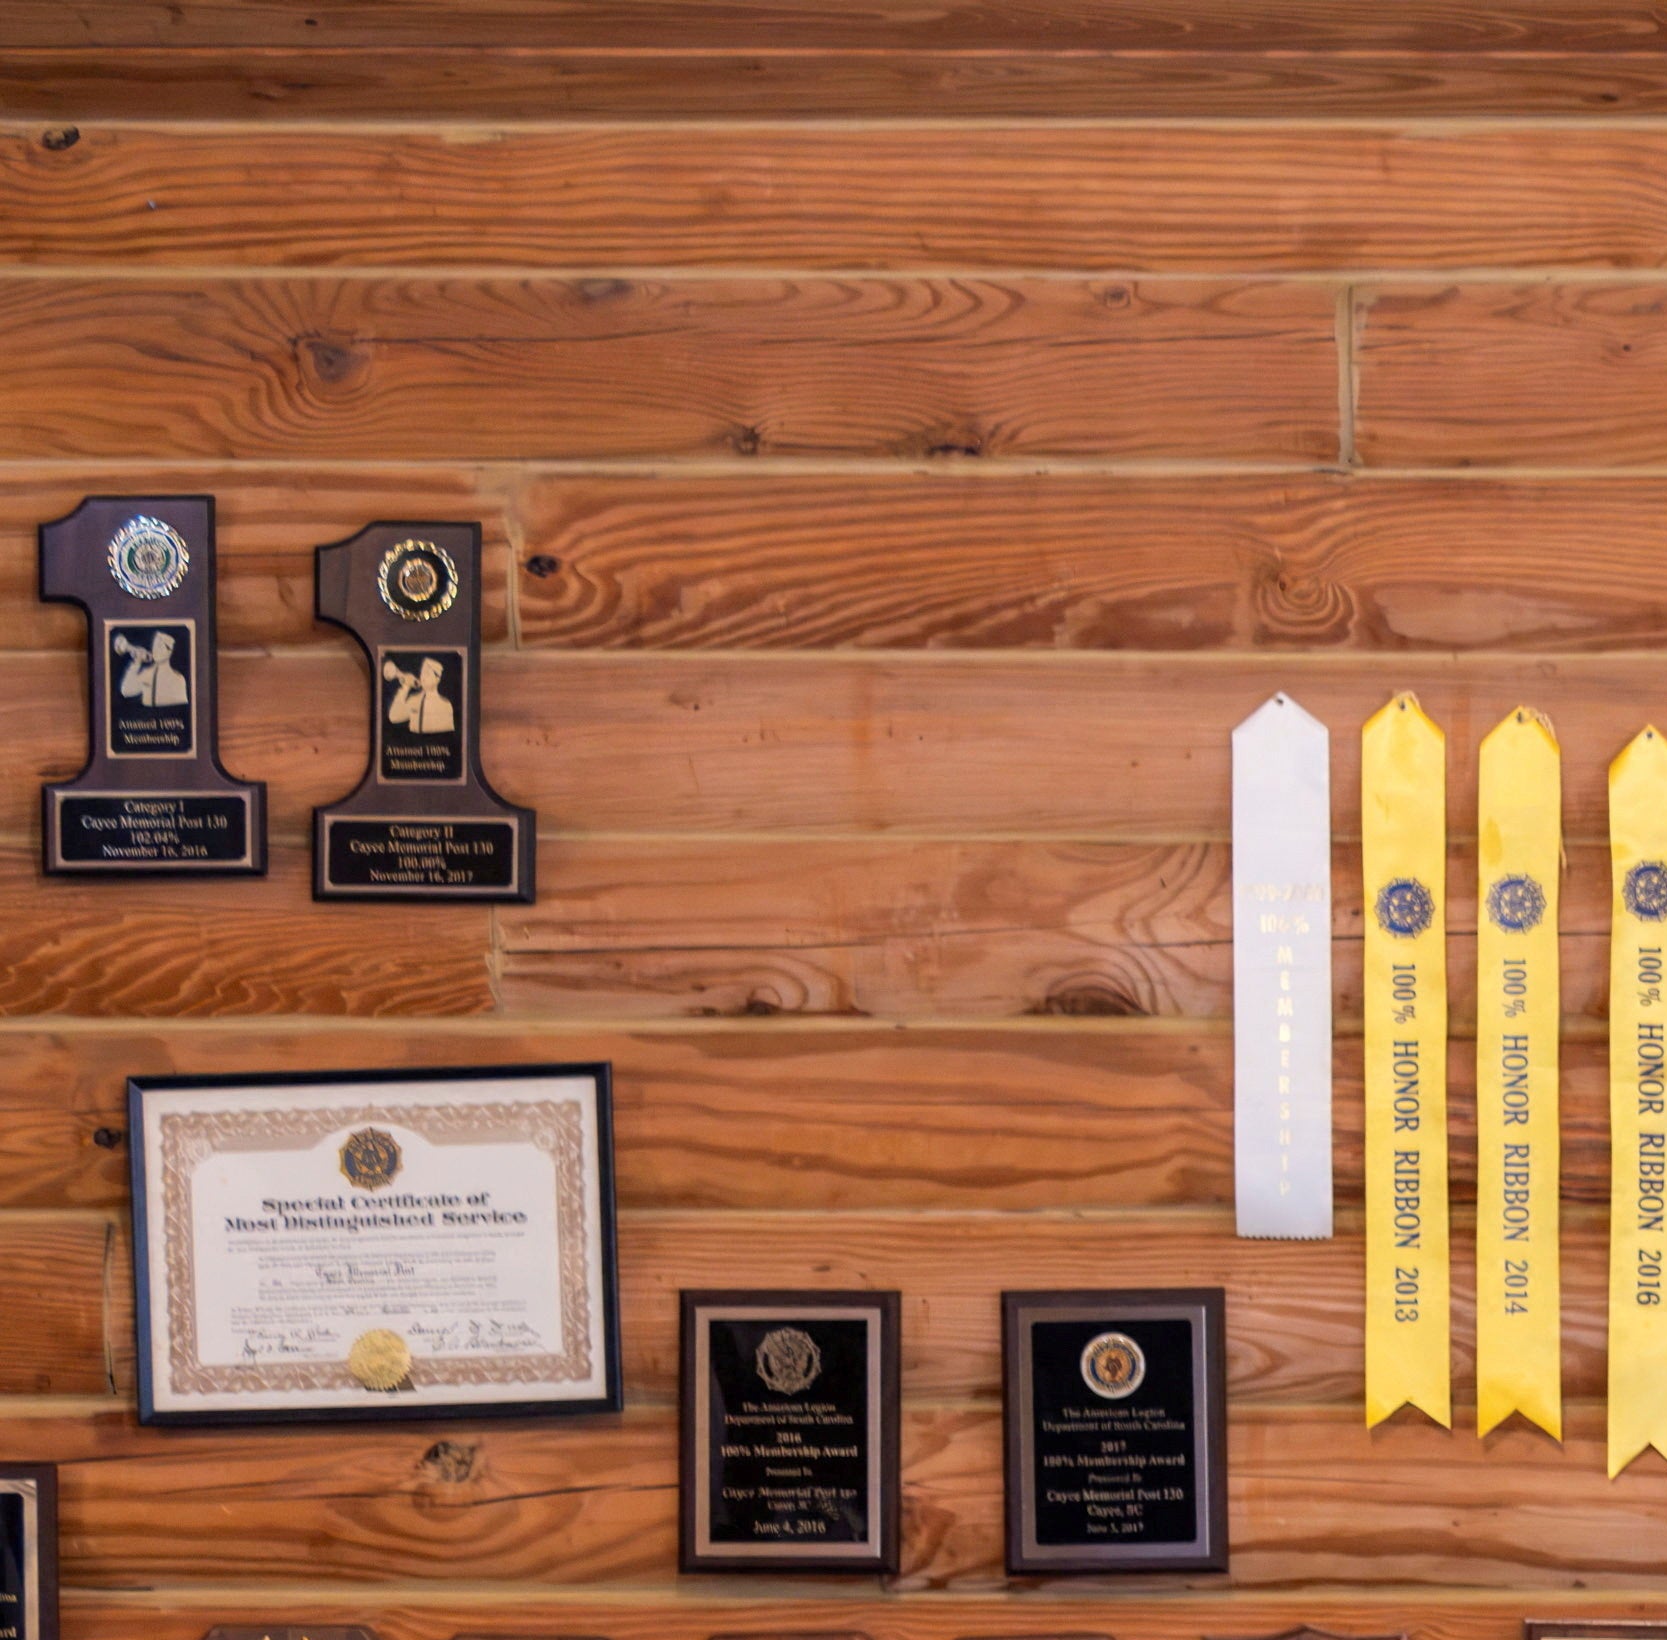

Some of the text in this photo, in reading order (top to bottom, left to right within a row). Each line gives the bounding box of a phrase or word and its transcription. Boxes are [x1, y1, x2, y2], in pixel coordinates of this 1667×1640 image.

[124, 801, 176, 816] Category
[81, 816, 228, 831] Cayce Memorial Post 130
[389, 825, 440, 840] Category
[350, 840, 494, 855] Cayce Memorial Post 130
[1637, 946, 1665, 1307] 100% HONOR RIBBON 2016
[1392, 963, 1420, 1323] 100% HONOR RIBBON 2013
[1502, 959, 1530, 1316] 100% HONOR RIBBON 2014
[261, 1192, 490, 1215] Special Certificate of
[224, 1210, 528, 1233] Most Distinguished Service
[721, 1445, 858, 1459] 100% Membership Award
[1043, 1454, 1185, 1468] 100% Membership Award
